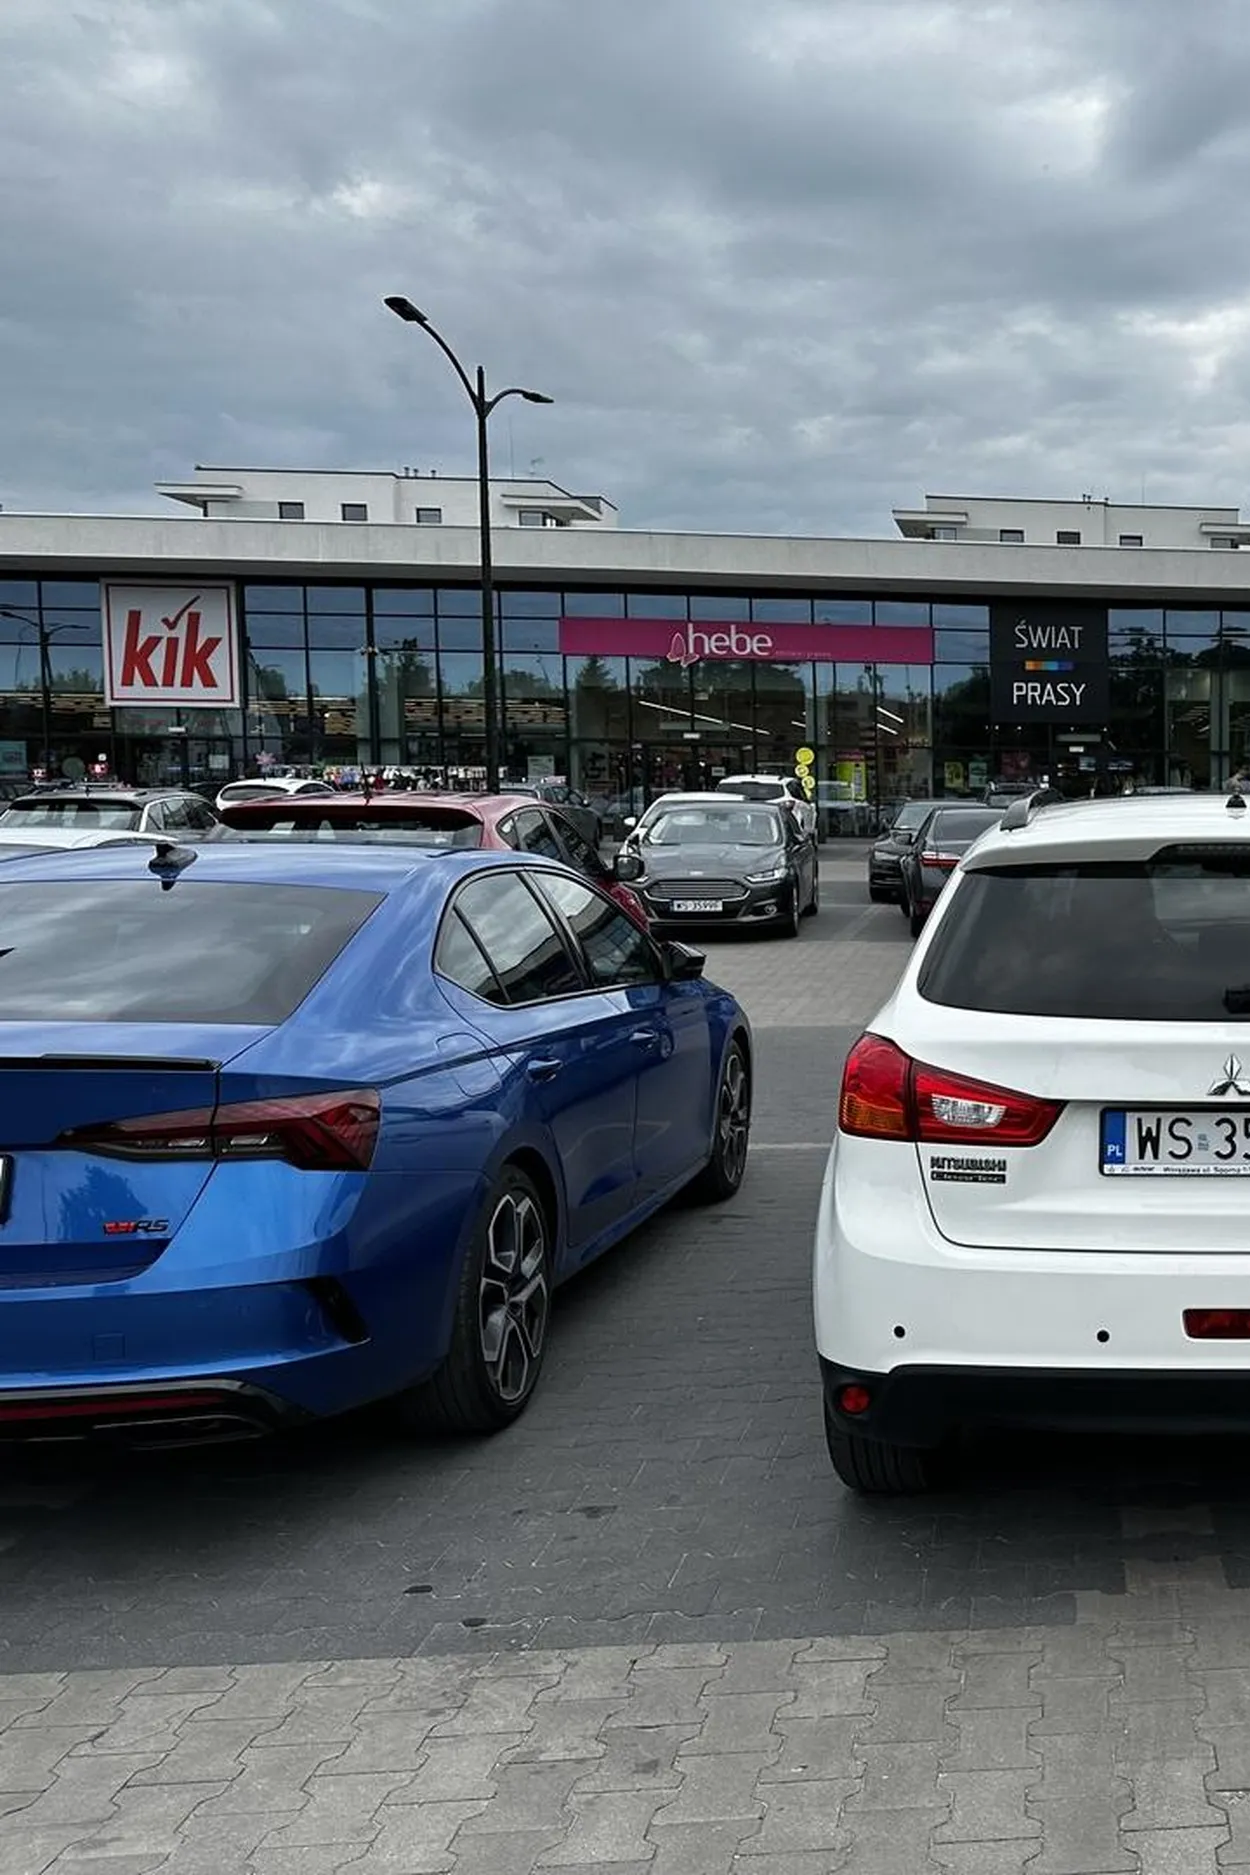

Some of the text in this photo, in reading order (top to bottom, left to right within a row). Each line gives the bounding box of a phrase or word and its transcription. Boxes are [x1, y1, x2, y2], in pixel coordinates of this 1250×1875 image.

[121, 600, 222, 688] kik
[688, 623, 773, 655] hebe
[1014, 619, 1083, 649] ŚWIAT
[1013, 682, 1086, 706] PRASY
[1107, 1144, 1122, 1156] PL
[1136, 1117, 1193, 1160] WS
[931, 1156, 1006, 1171] MITSUBISHI
